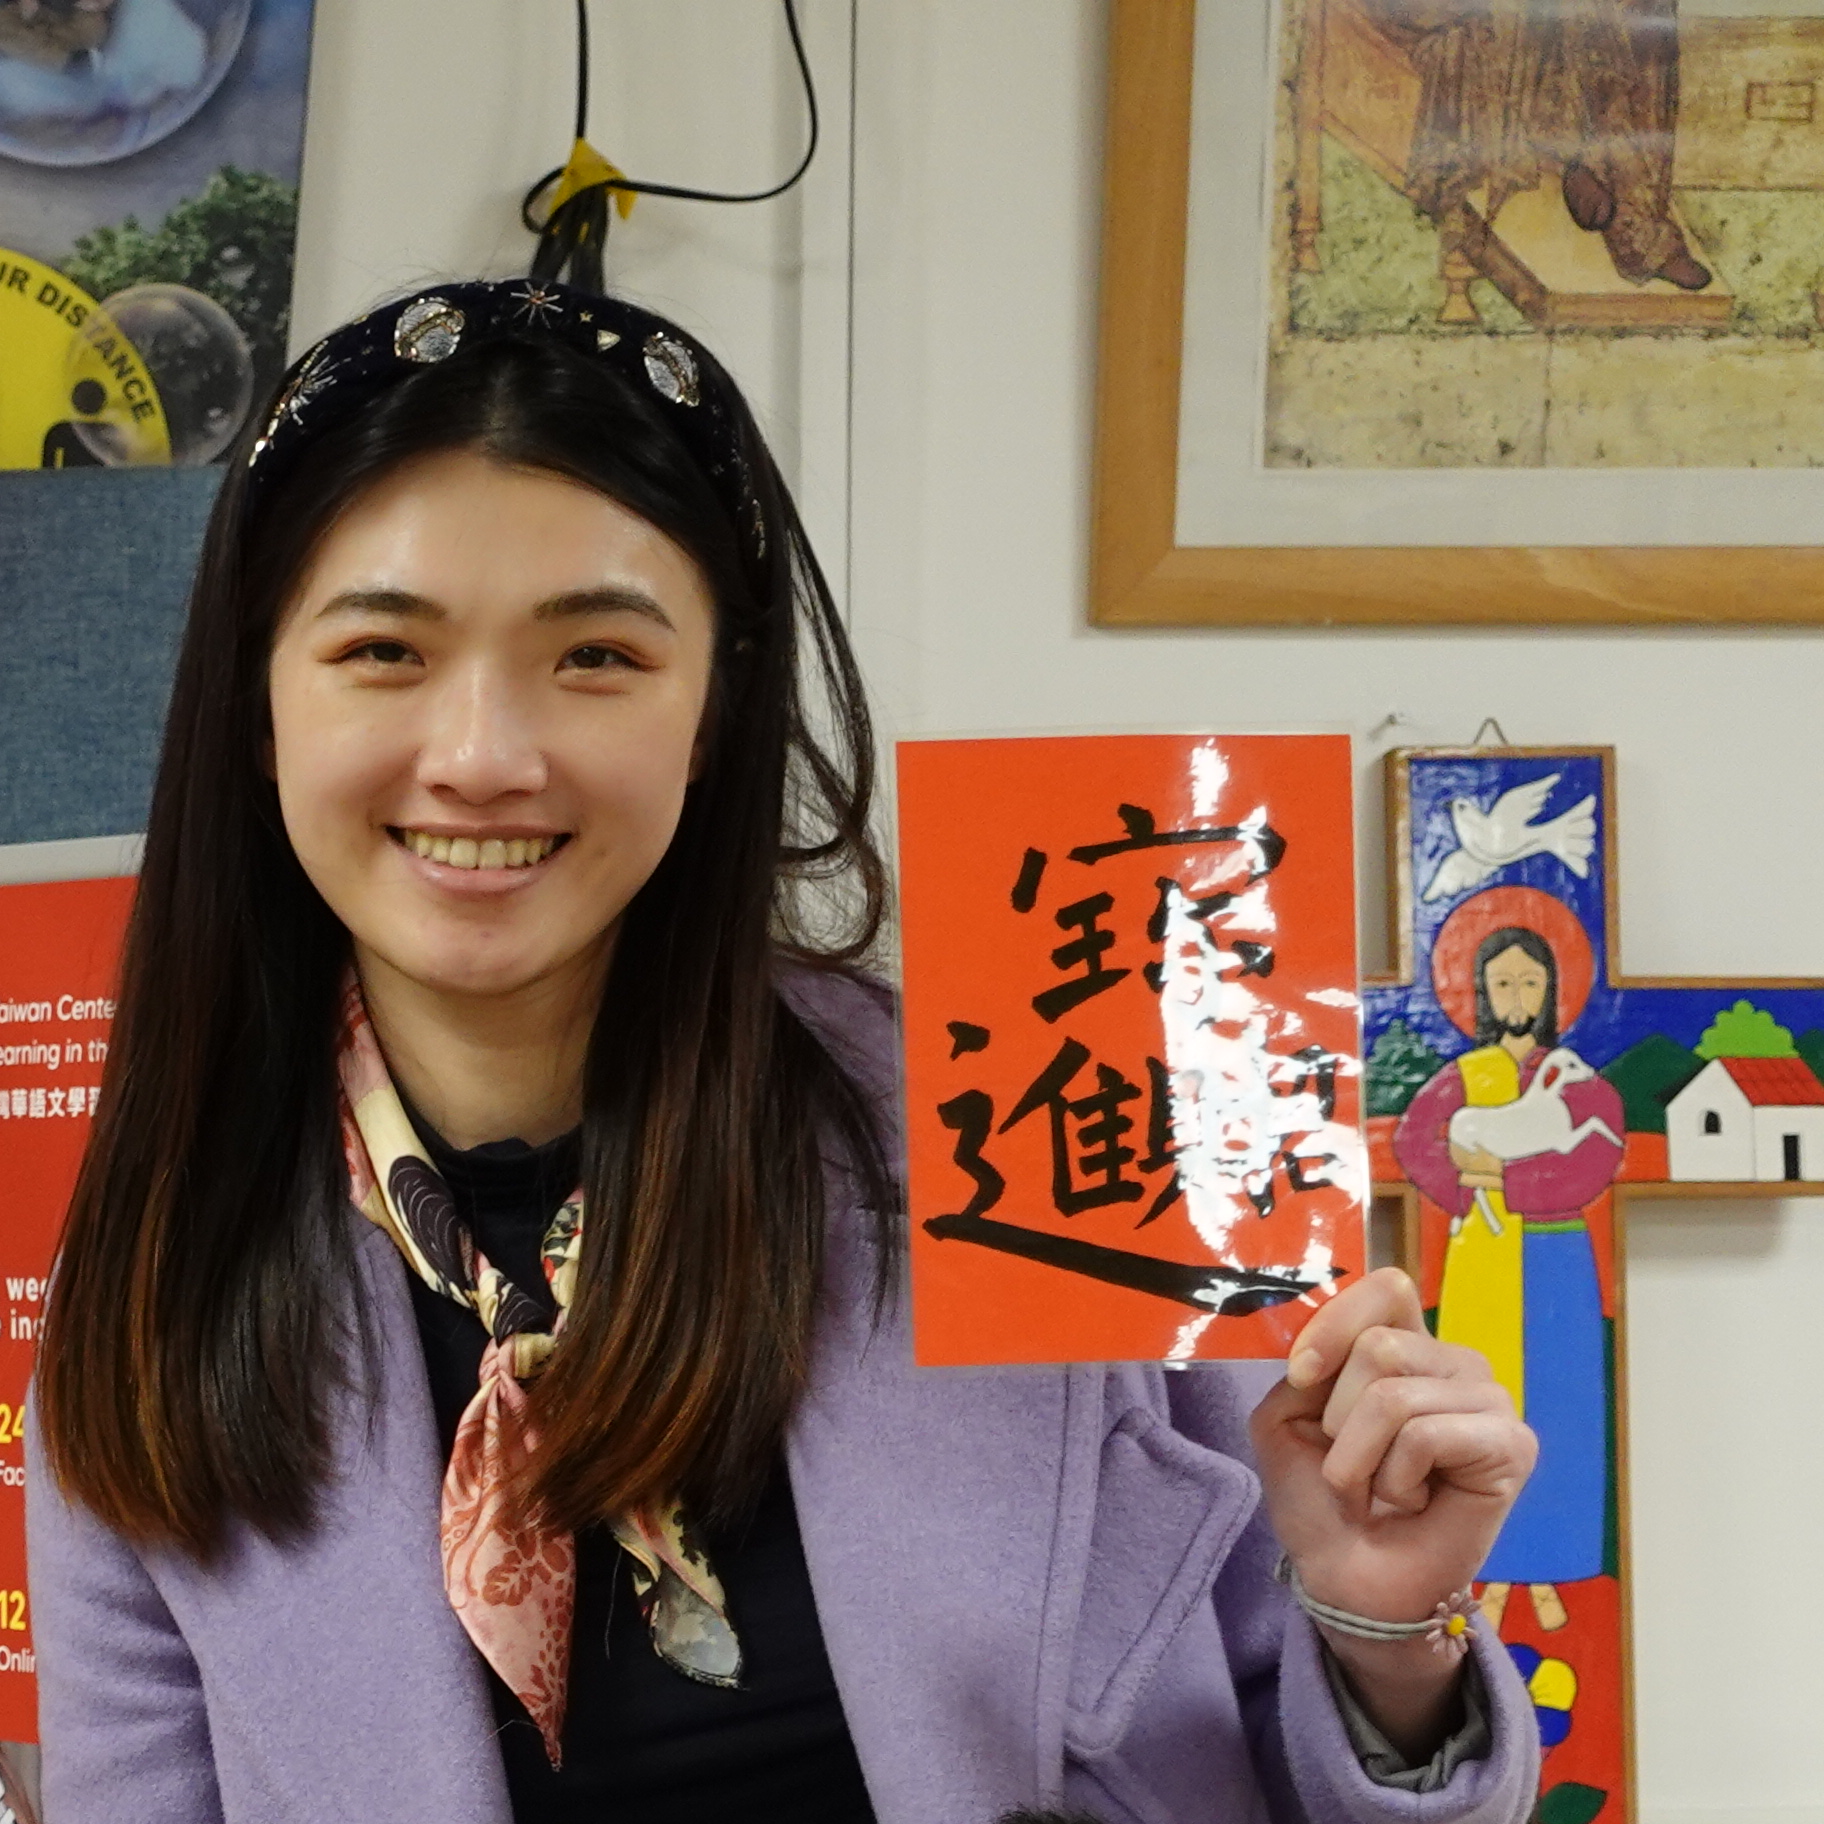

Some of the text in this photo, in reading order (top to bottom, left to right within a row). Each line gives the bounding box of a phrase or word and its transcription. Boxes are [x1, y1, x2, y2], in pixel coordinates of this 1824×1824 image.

[38, 283, 158, 424] DISTANCE
[57, 994, 117, 1021] Cente
[65, 1038, 82, 1062] in
[88, 1038, 109, 1062] th
